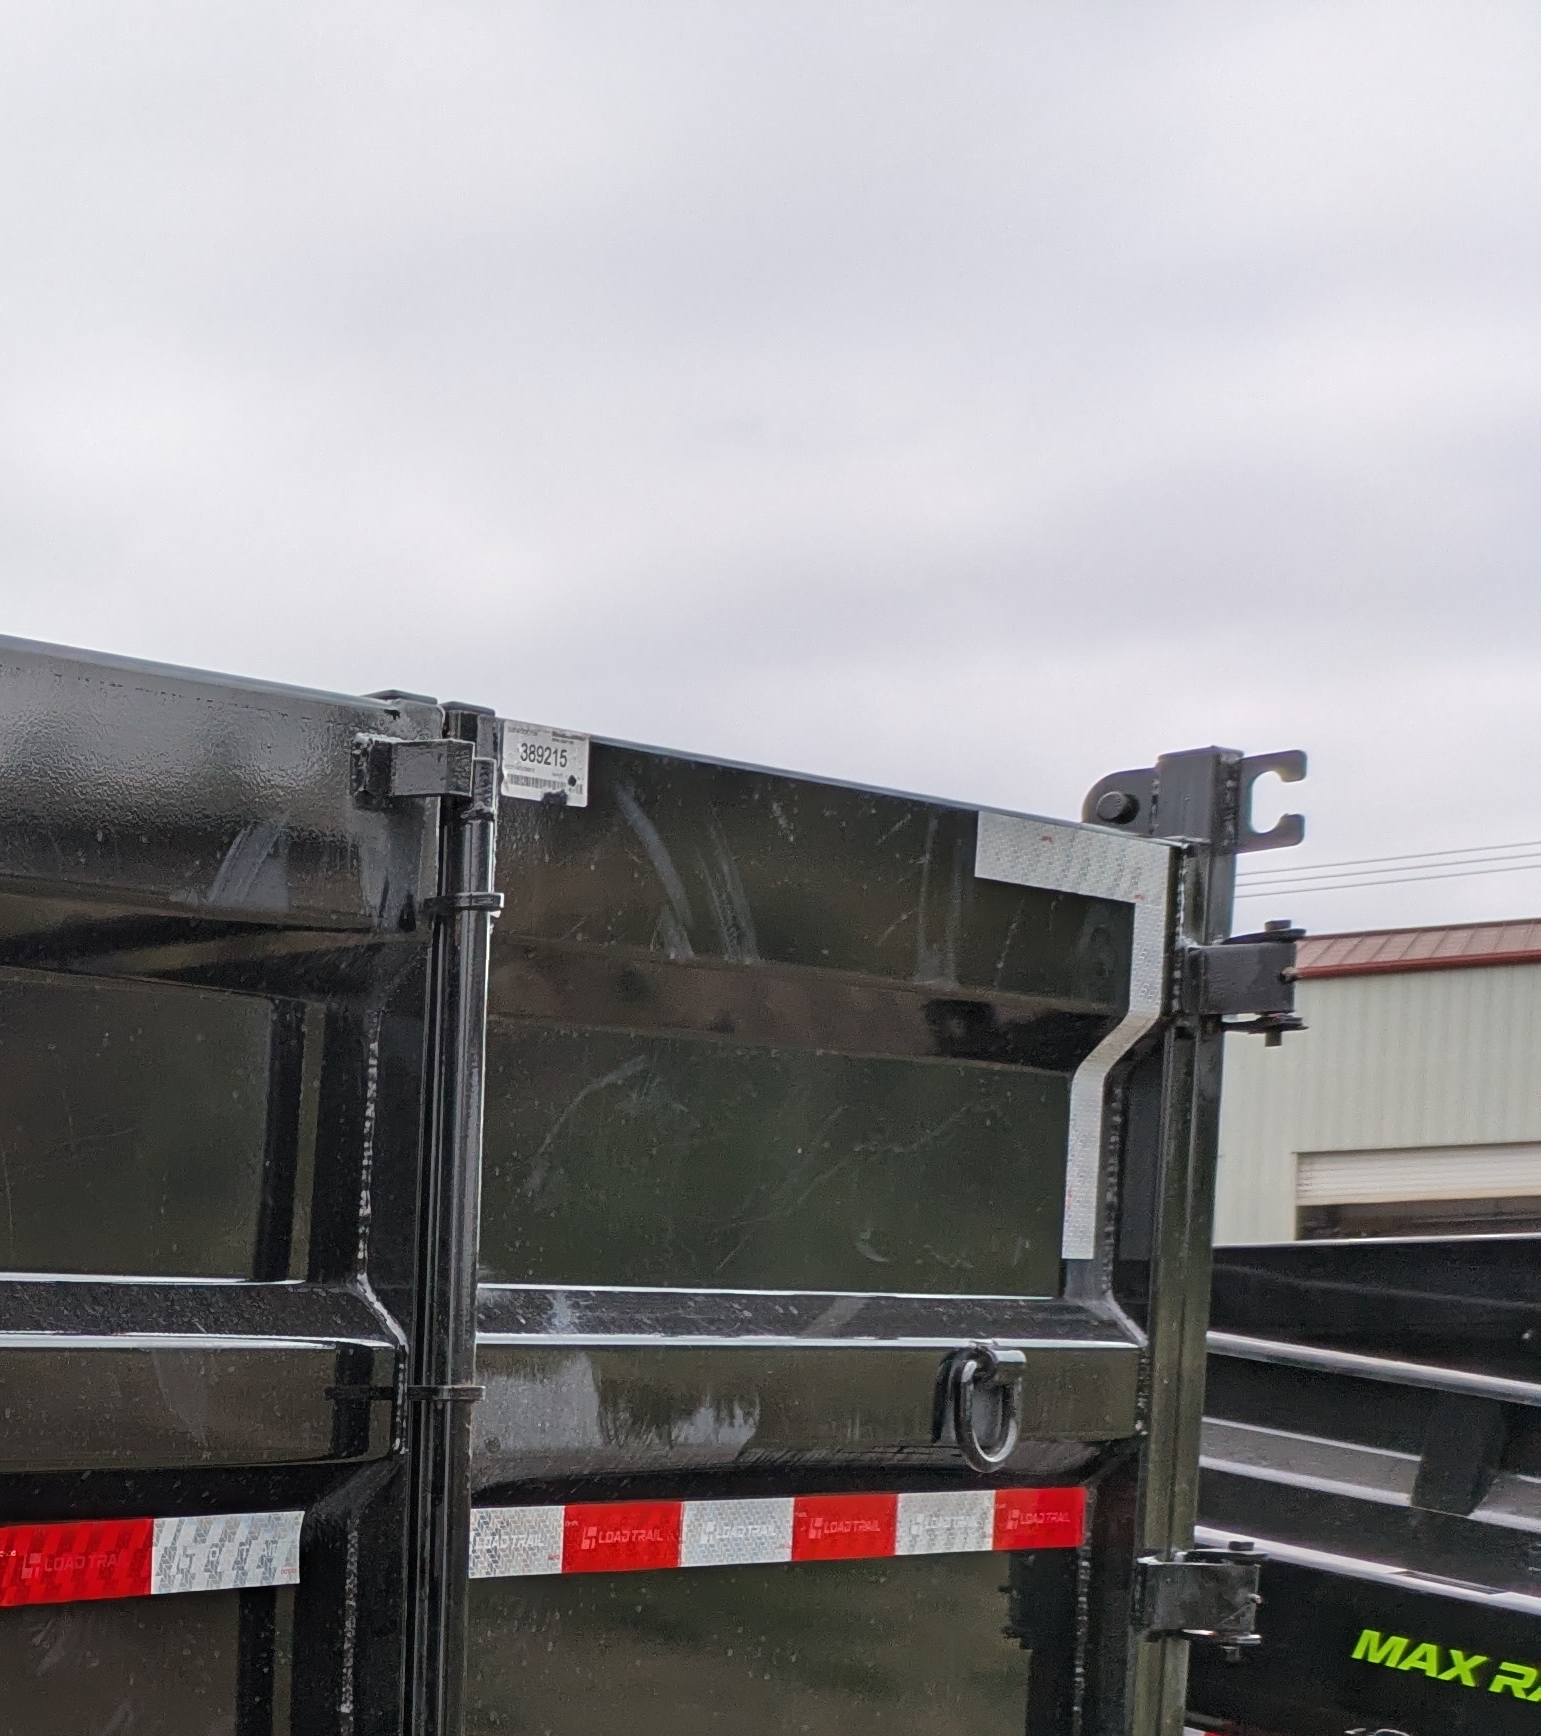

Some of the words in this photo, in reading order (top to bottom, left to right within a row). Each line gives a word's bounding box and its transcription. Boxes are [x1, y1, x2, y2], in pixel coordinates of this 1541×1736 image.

[519, 742, 568, 768] 389215
[1020, 1512, 1044, 1525] LOAD
[1045, 1511, 1071, 1524] TRAIL
[823, 1521, 852, 1534] LOAD
[853, 1519, 881, 1533] TRAIL
[475, 1534, 509, 1549] LOAD
[510, 1533, 545, 1547] TRAIL
[598, 1531, 630, 1544] LOAD
[631, 1529, 664, 1542] TRAIL
[44, 1554, 86, 1572] LOAD
[88, 1551, 120, 1570] TRA
[1350, 1629, 1489, 1687] MAX
